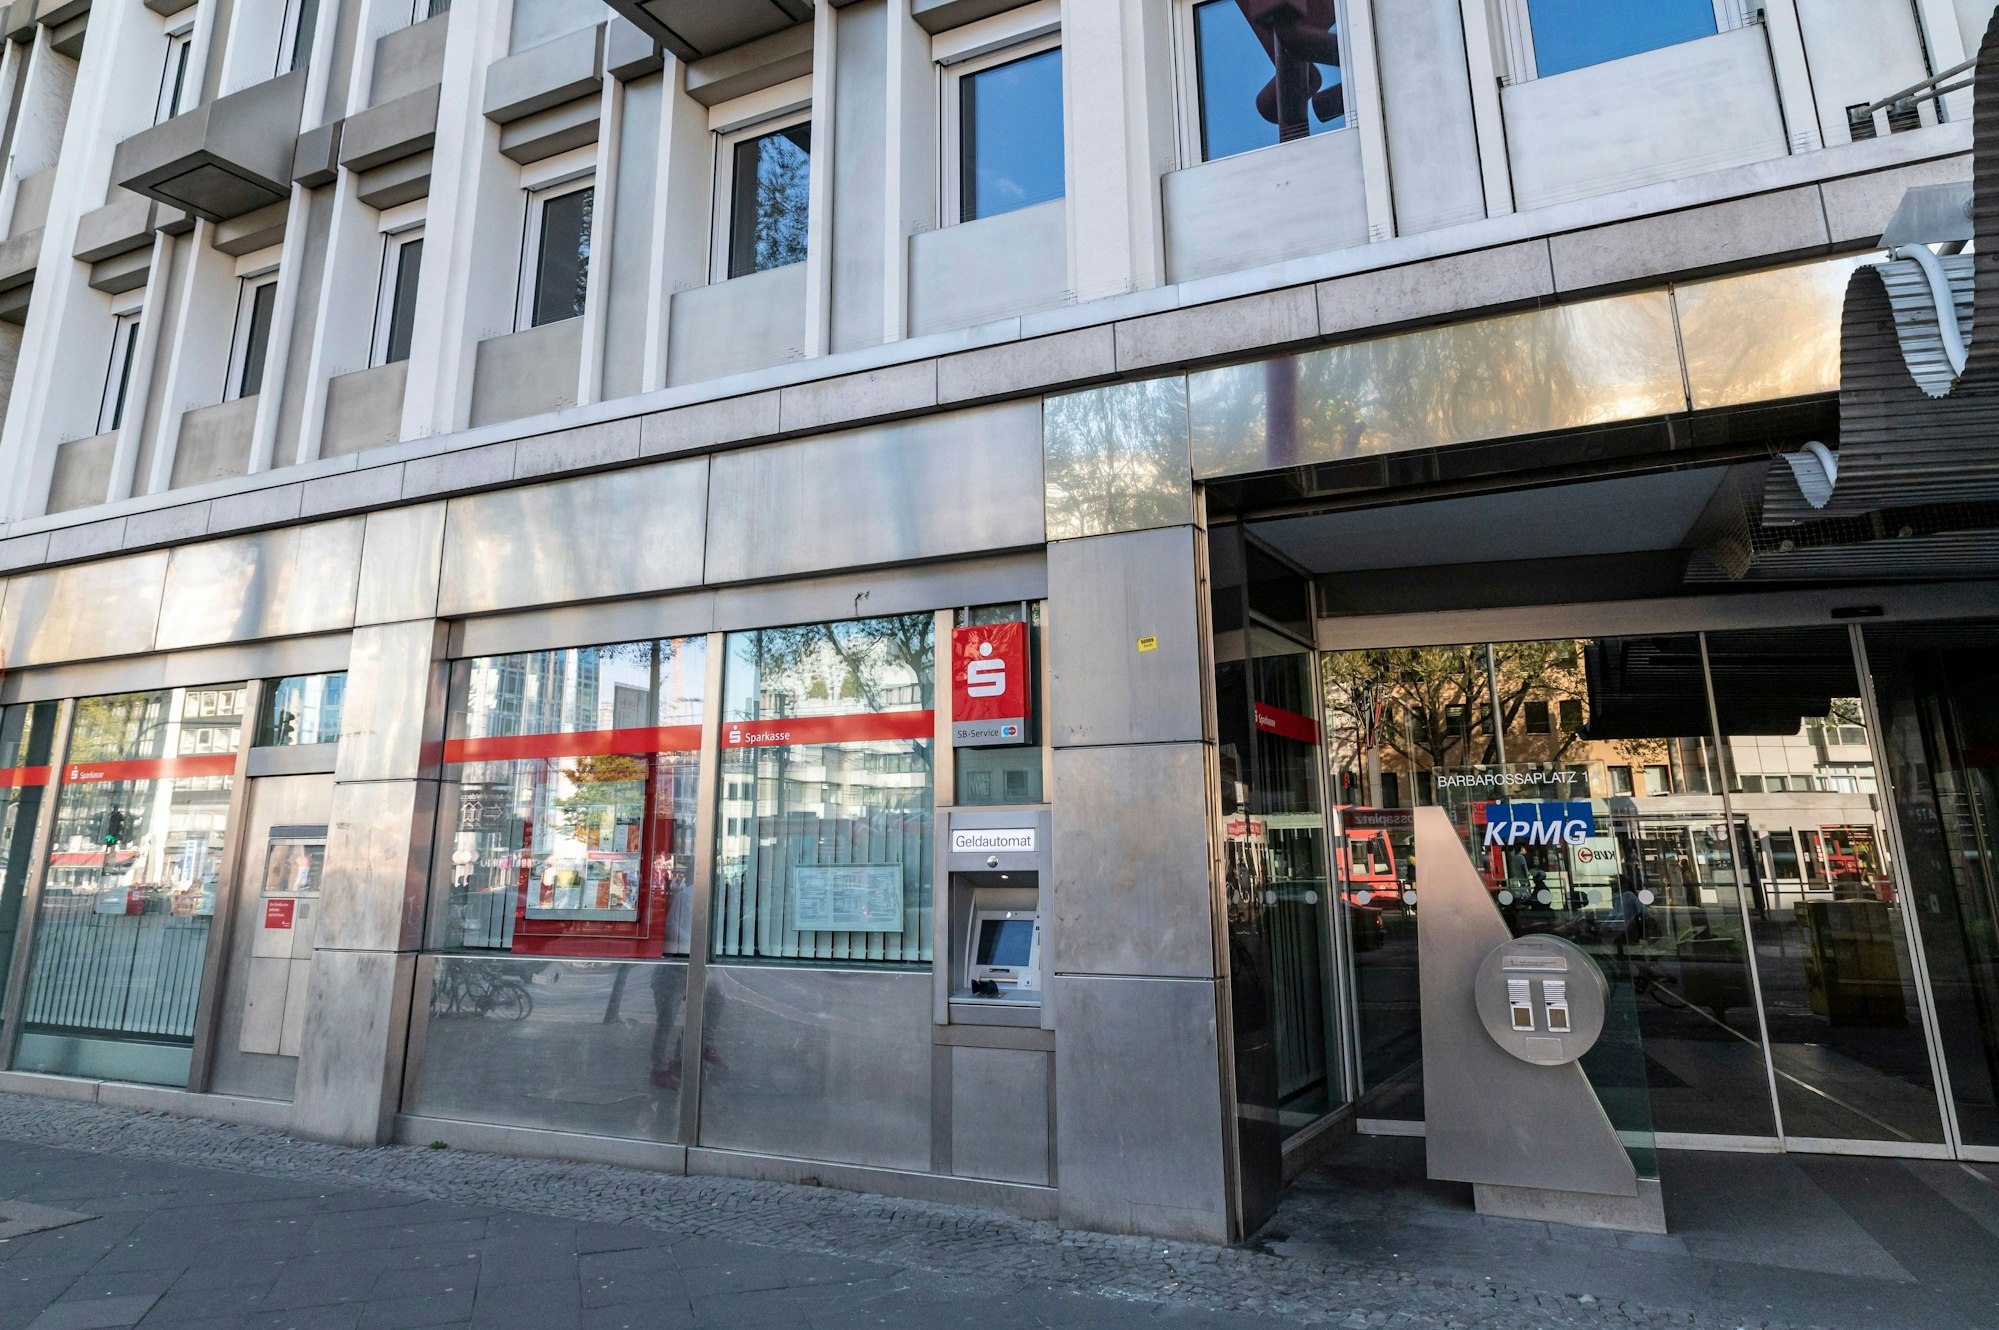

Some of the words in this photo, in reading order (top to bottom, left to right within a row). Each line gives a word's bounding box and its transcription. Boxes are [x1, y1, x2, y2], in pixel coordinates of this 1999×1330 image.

[745, 731, 790, 744] Sparkasse
[957, 728, 999, 739] SB-Service
[1437, 771, 1578, 788] BARBAROSSAPLATZ
[1484, 819, 1588, 846] KPMG
[956, 835, 1032, 848] Geldautomat
